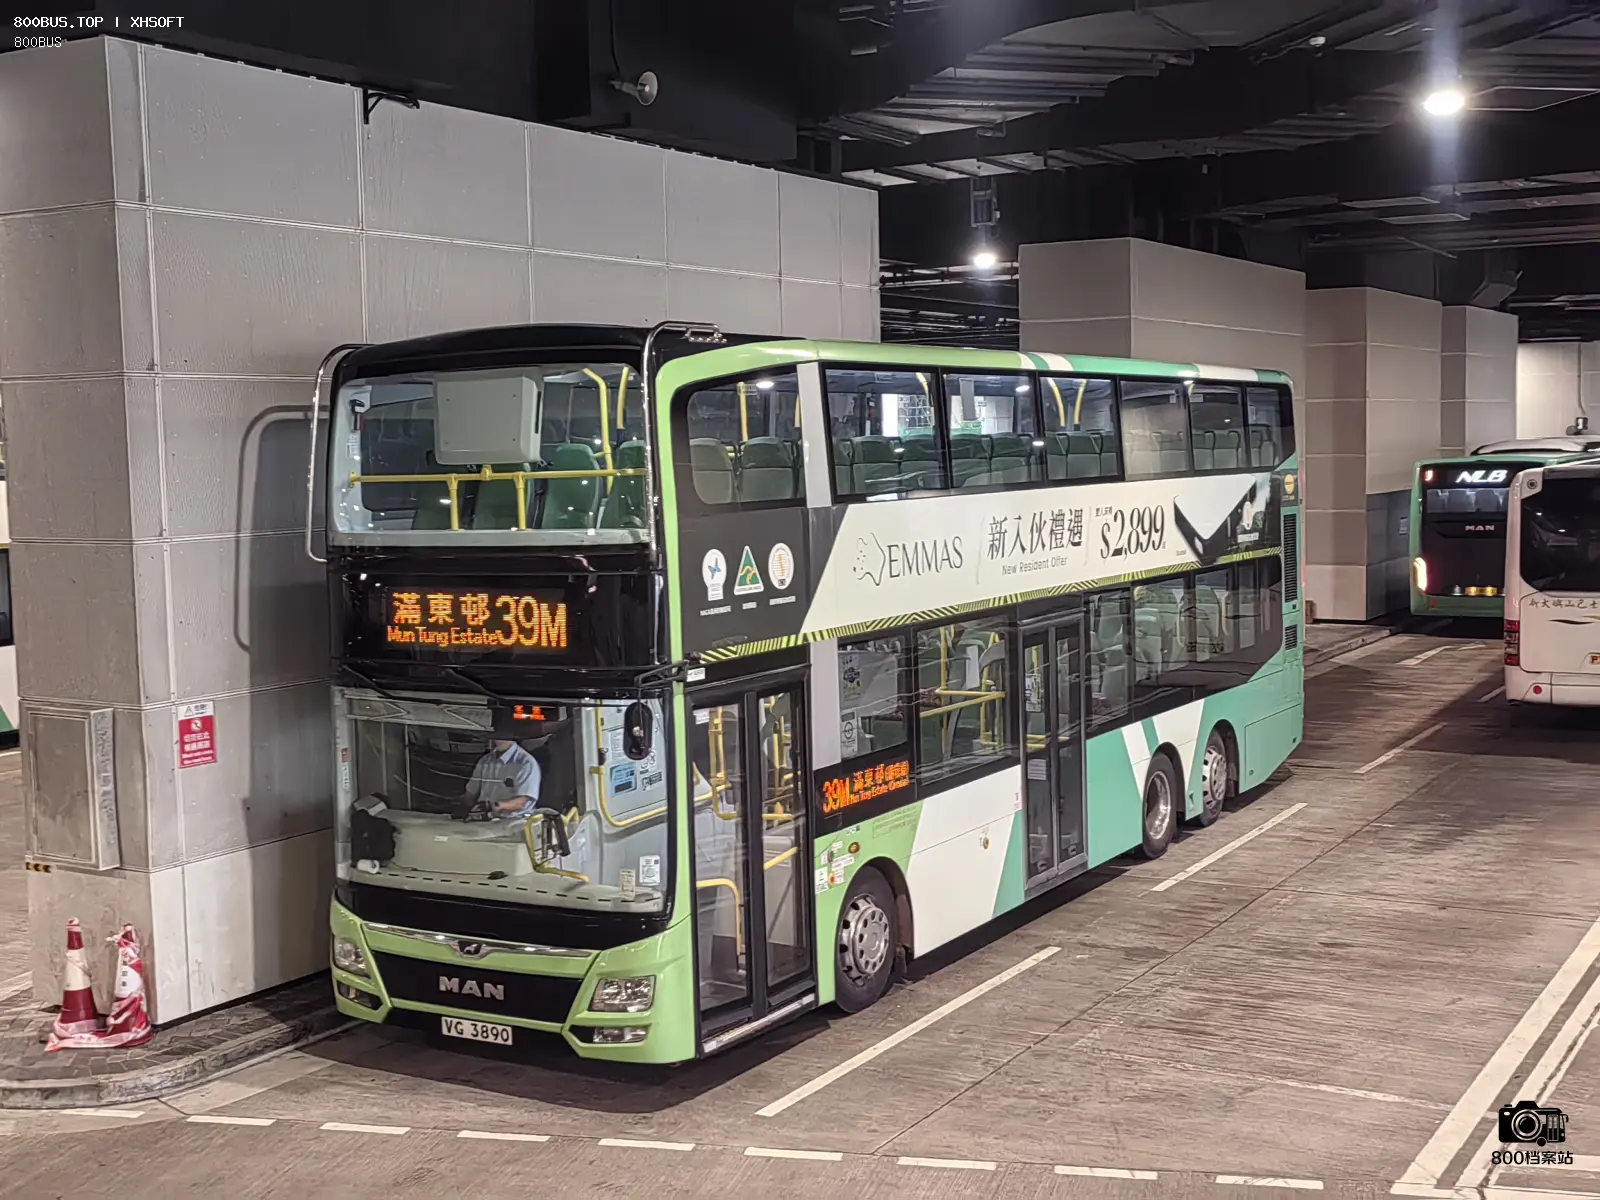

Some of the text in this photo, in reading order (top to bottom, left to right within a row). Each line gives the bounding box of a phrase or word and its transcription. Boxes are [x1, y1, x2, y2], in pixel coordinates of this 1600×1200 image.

[1455, 469, 1508, 483] NLB
[987, 508, 1083, 560] 新入伙禮遇
[1100, 504, 1165, 562] $2,899
[886, 535, 963, 579] EMMAS
[1002, 555, 1068, 576] New Resident Offer
[392, 592, 490, 626] 滿東邨
[495, 595, 567, 647] 39M
[387, 625, 501, 647] Mun Tung Estate
[439, 976, 505, 1000] MAN
[444, 1019, 510, 1042] VG 3890
